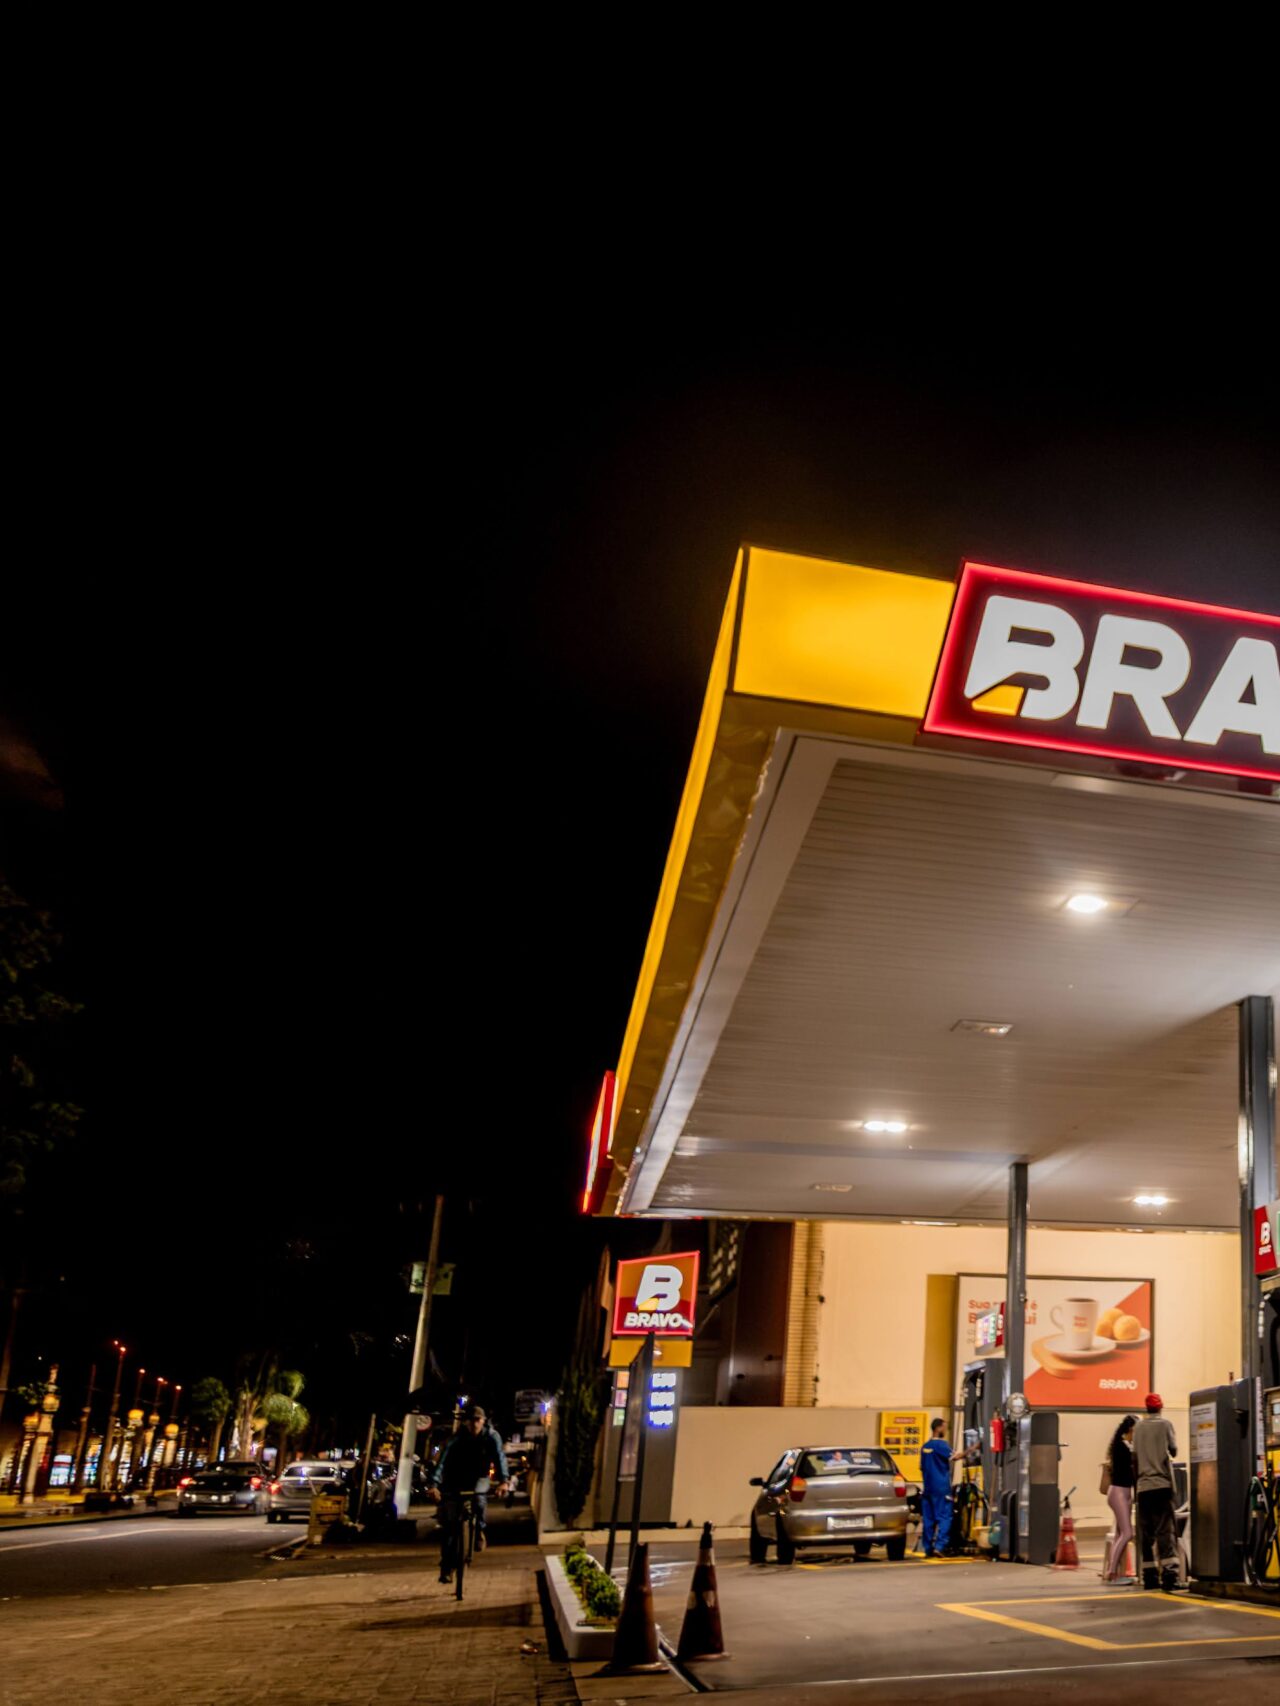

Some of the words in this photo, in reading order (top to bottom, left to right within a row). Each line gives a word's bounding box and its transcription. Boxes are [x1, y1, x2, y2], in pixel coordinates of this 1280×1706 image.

[635, 1264, 683, 1312] B
[624, 1312, 683, 1328] BRAVO
[1099, 1379, 1138, 1390] BRAVO
